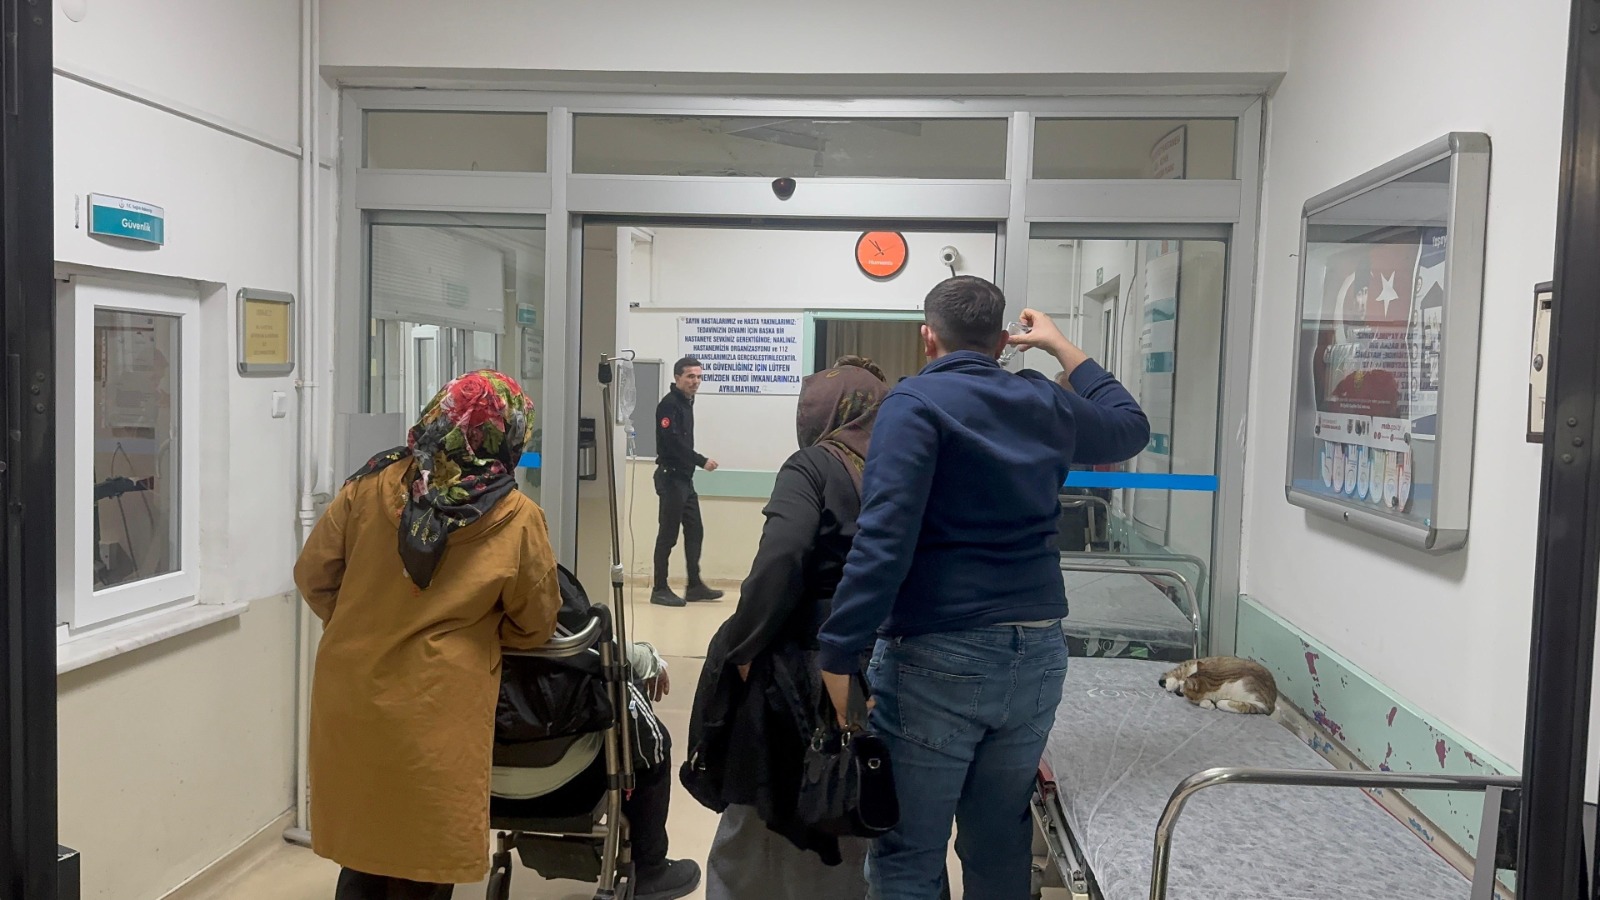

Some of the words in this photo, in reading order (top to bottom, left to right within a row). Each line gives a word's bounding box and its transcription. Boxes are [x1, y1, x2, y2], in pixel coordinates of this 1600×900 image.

[122, 218, 150, 232] Güvenlik
[686, 317, 700, 325] SAYIN
[701, 317, 736, 325] HASTALARIMIZ
[744, 317, 760, 325] HASTA
[696, 326, 726, 334] TEDAVİNİZİN
[728, 326, 746, 334] DEVAMI
[747, 326, 758, 335] İÇİN
[758, 327, 775, 335] BAŞKA
[684, 335, 712, 343] HASTANEYE
[713, 335, 736, 343] SEVKİNİZ
[693, 344, 729, 352] HASTANEMİZİN
[730, 344, 771, 352] ORGANİZASYONU
[712, 362, 753, 372] GÜVENLİĞİNİZ
[754, 363, 767, 373] İÇİN
[768, 363, 790, 372] LÜTFEN
[701, 372, 730, 382] NEMİZDEN
[732, 372, 749, 382] KENDİ
[750, 372, 800, 383] İMKANLARINIZLA
[718, 385, 762, 393] AYRILMAYINIZ.
